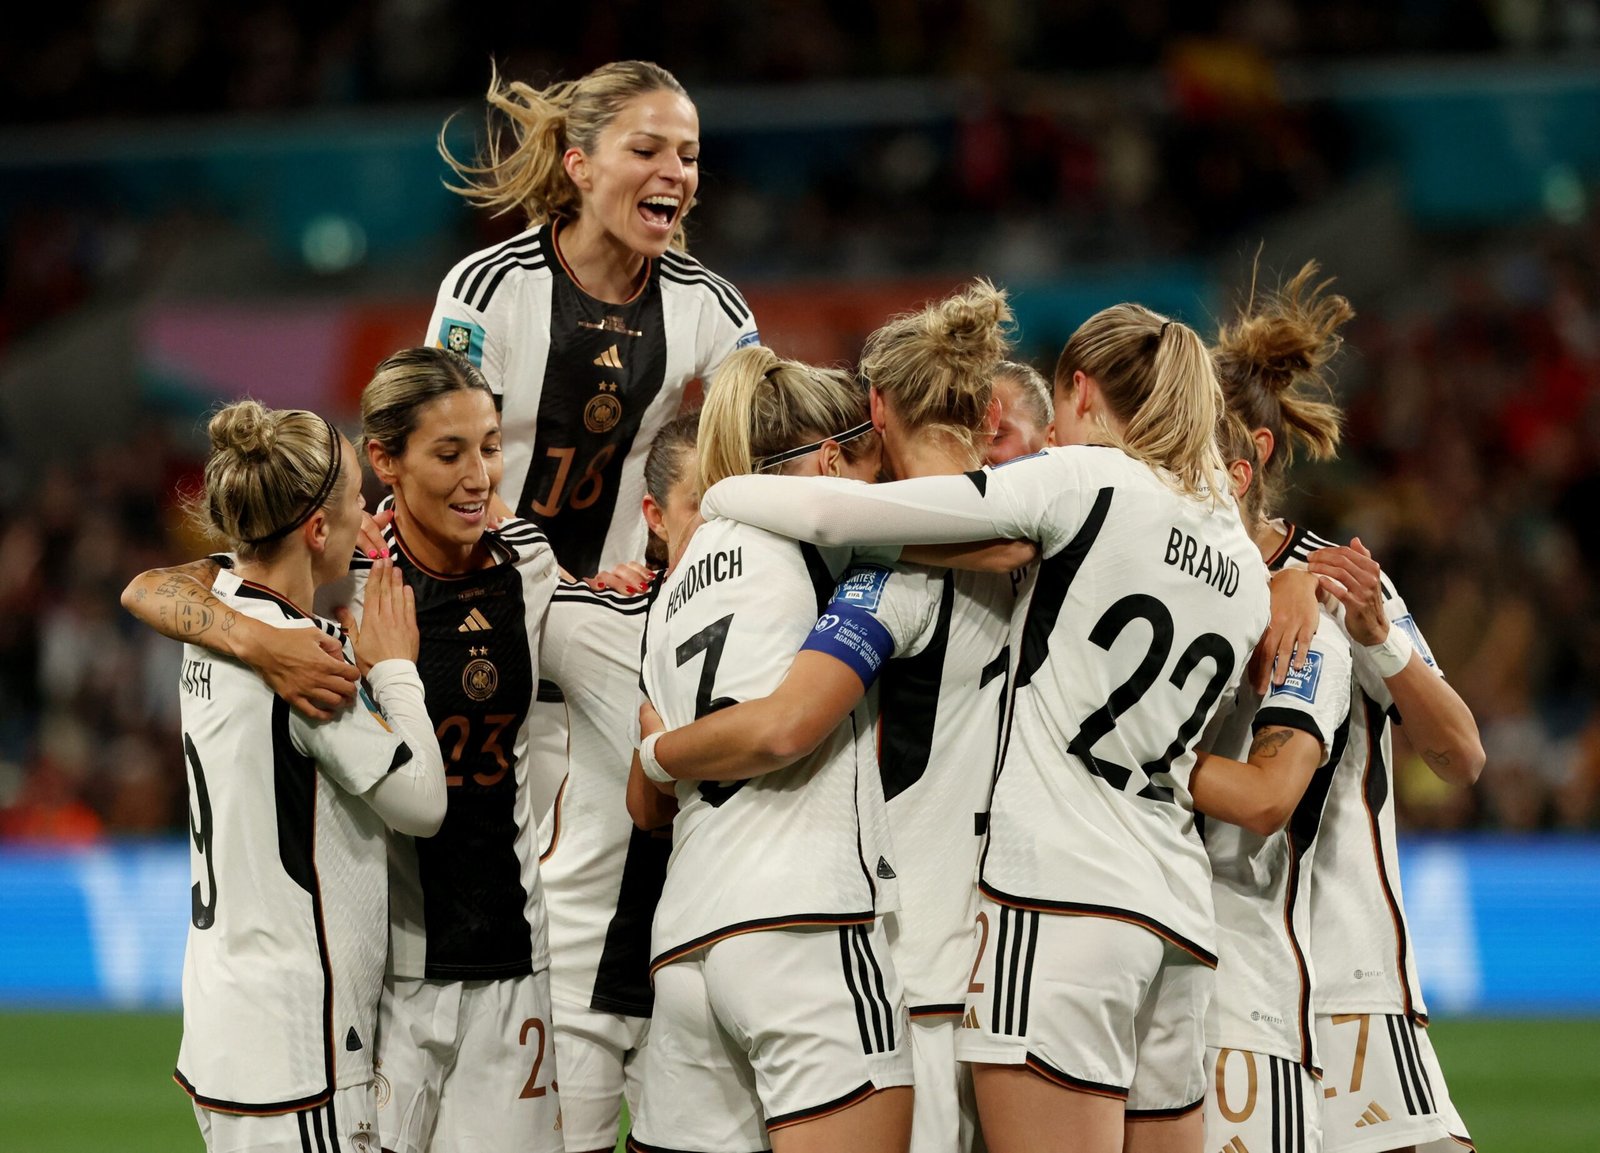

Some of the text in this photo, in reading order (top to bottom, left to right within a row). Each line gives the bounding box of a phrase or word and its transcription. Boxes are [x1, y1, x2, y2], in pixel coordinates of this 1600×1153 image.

[531, 444, 615, 517] 18
[665, 546, 742, 623] HENDRICH
[1164, 527, 1241, 598] BRAND
[834, 633, 860, 651] AGAINST
[838, 625, 862, 643] ENDING
[1066, 594, 1236, 804] 22
[436, 713, 517, 787] 23
[519, 1016, 558, 1099] 2
